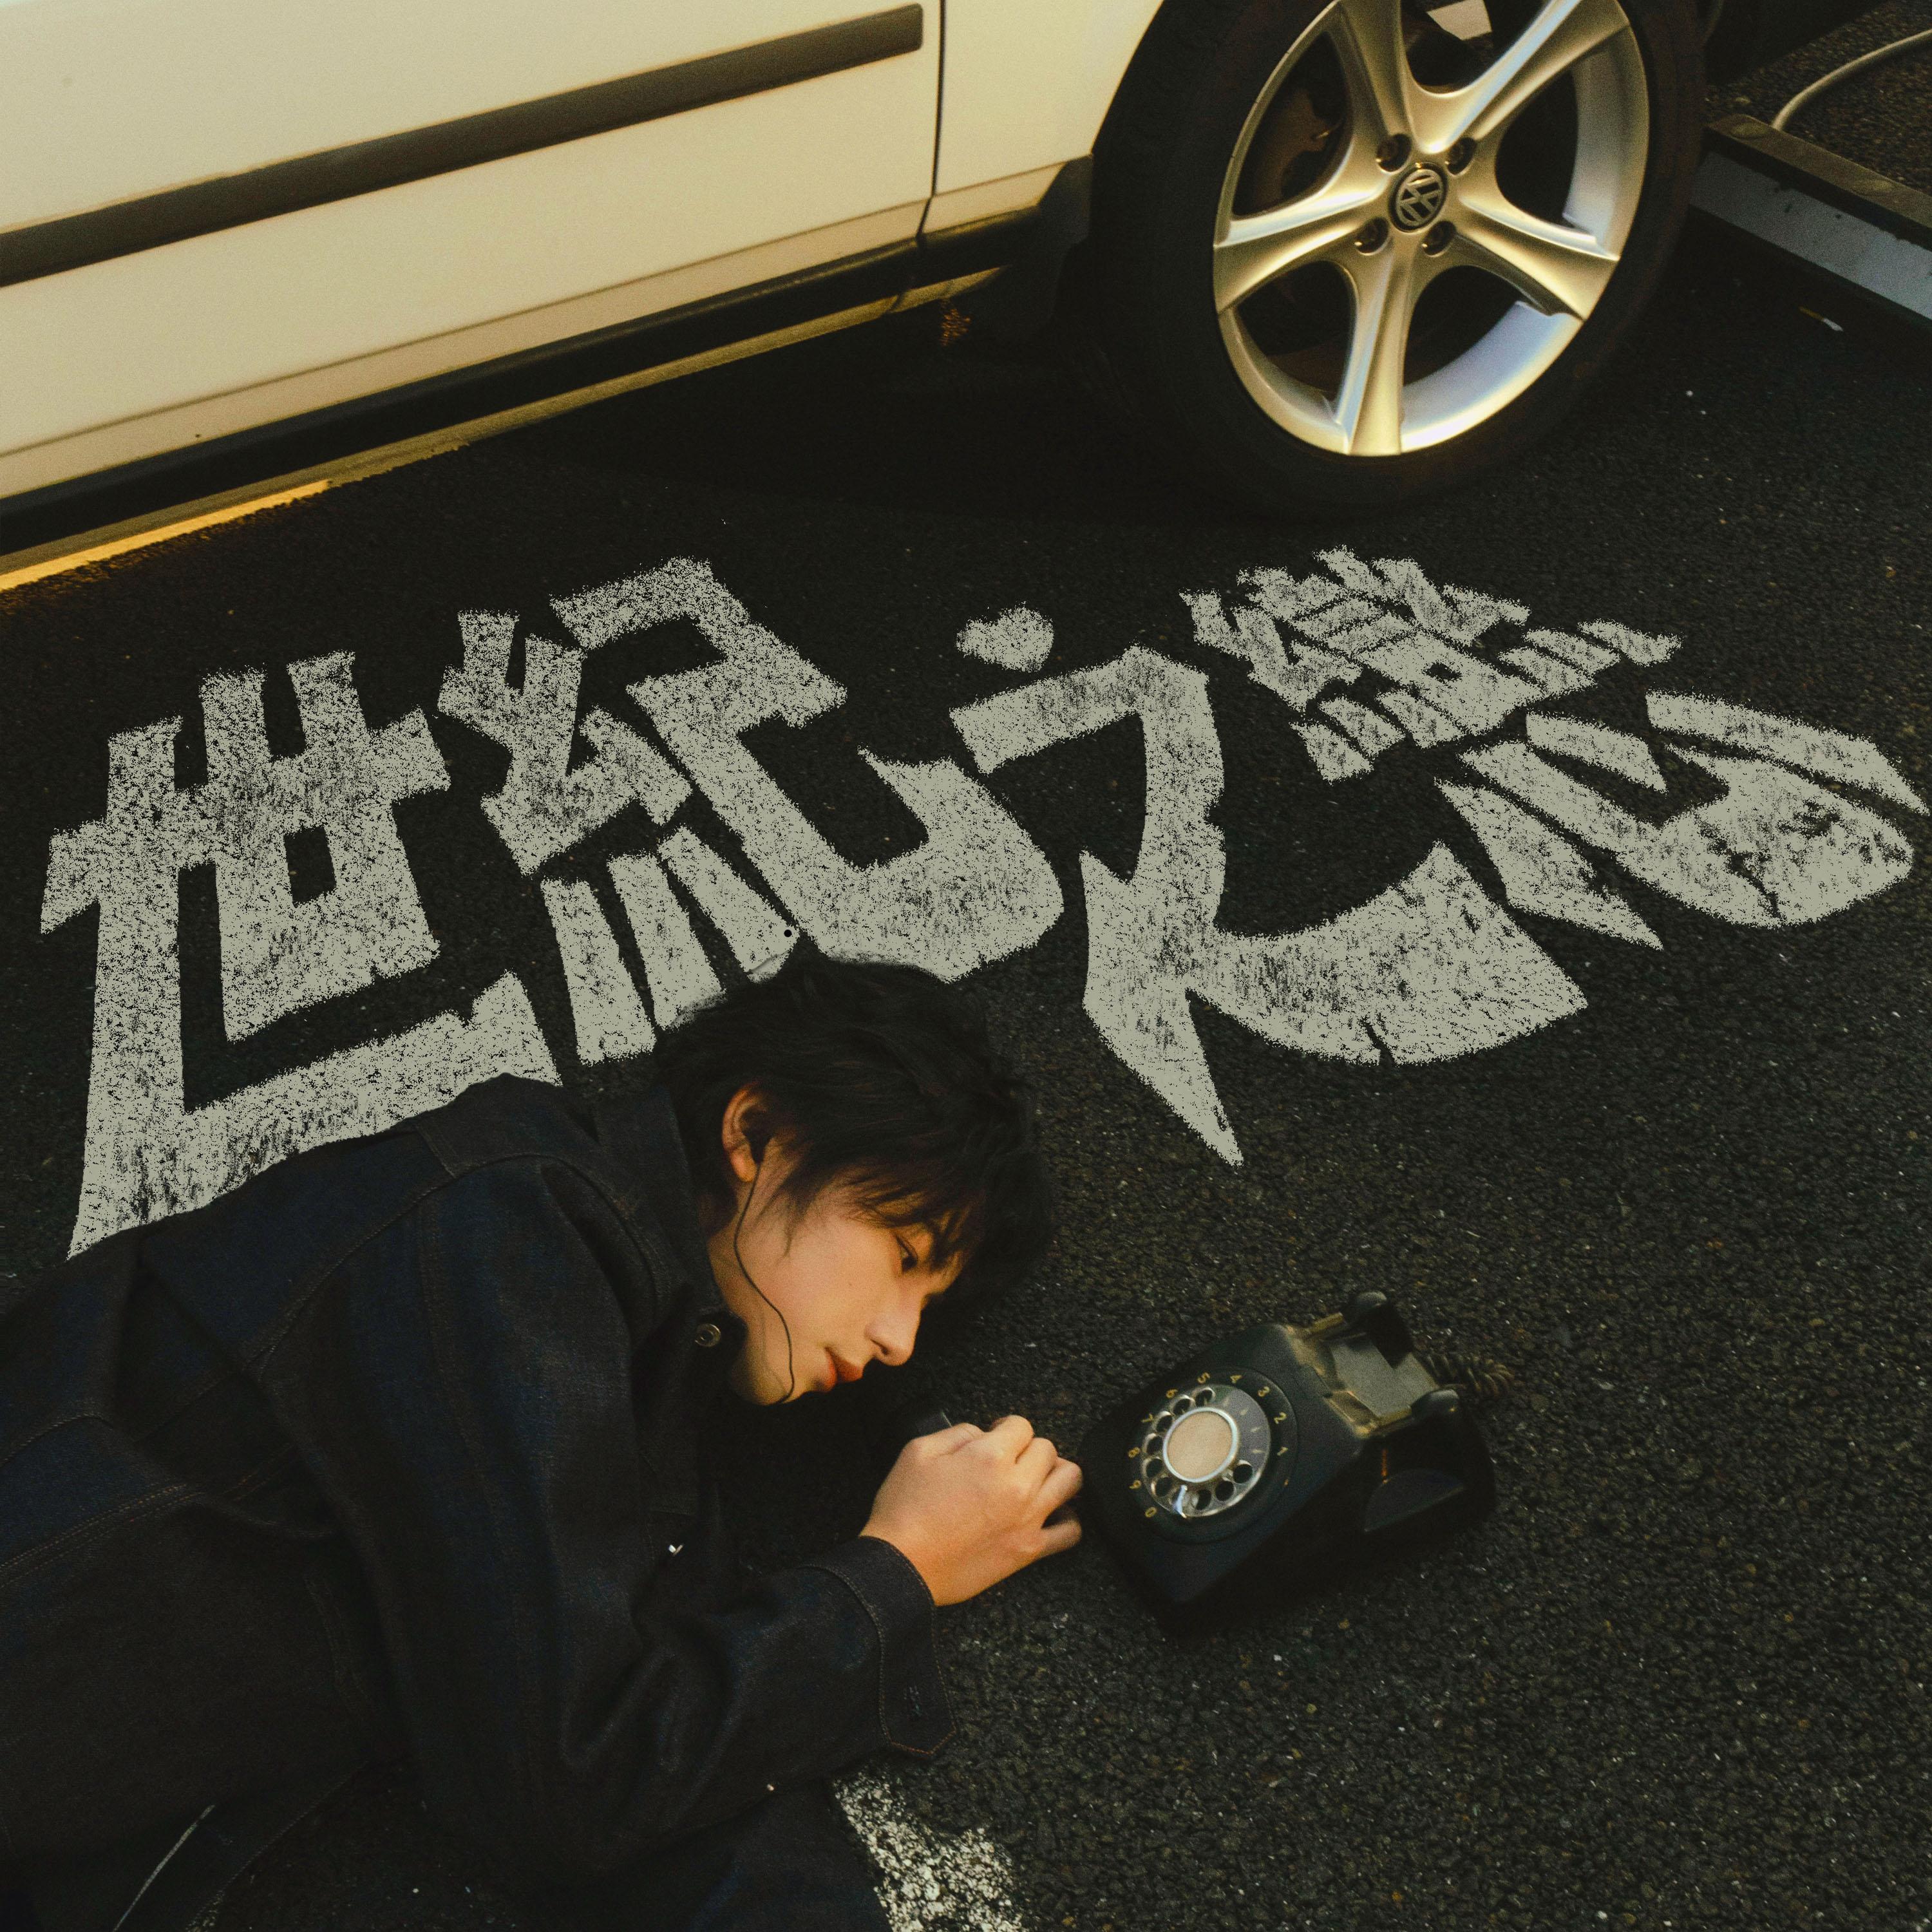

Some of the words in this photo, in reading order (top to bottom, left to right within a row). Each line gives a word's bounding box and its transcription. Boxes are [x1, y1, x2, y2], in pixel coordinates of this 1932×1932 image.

[1197, 1372, 1211, 1384] 5
[1230, 1374, 1242, 1383] 4
[1166, 1388, 1179, 1399] 6
[1258, 1386, 1270, 1397] 3
[1141, 1414, 1153, 1423] 7
[1274, 1412, 1287, 1424] 2
[1128, 1446, 1141, 1459] 8
[1277, 1446, 1288, 1456] 1
[1129, 1480, 1142, 1490] 9
[1144, 1506, 1157, 1518] 0
